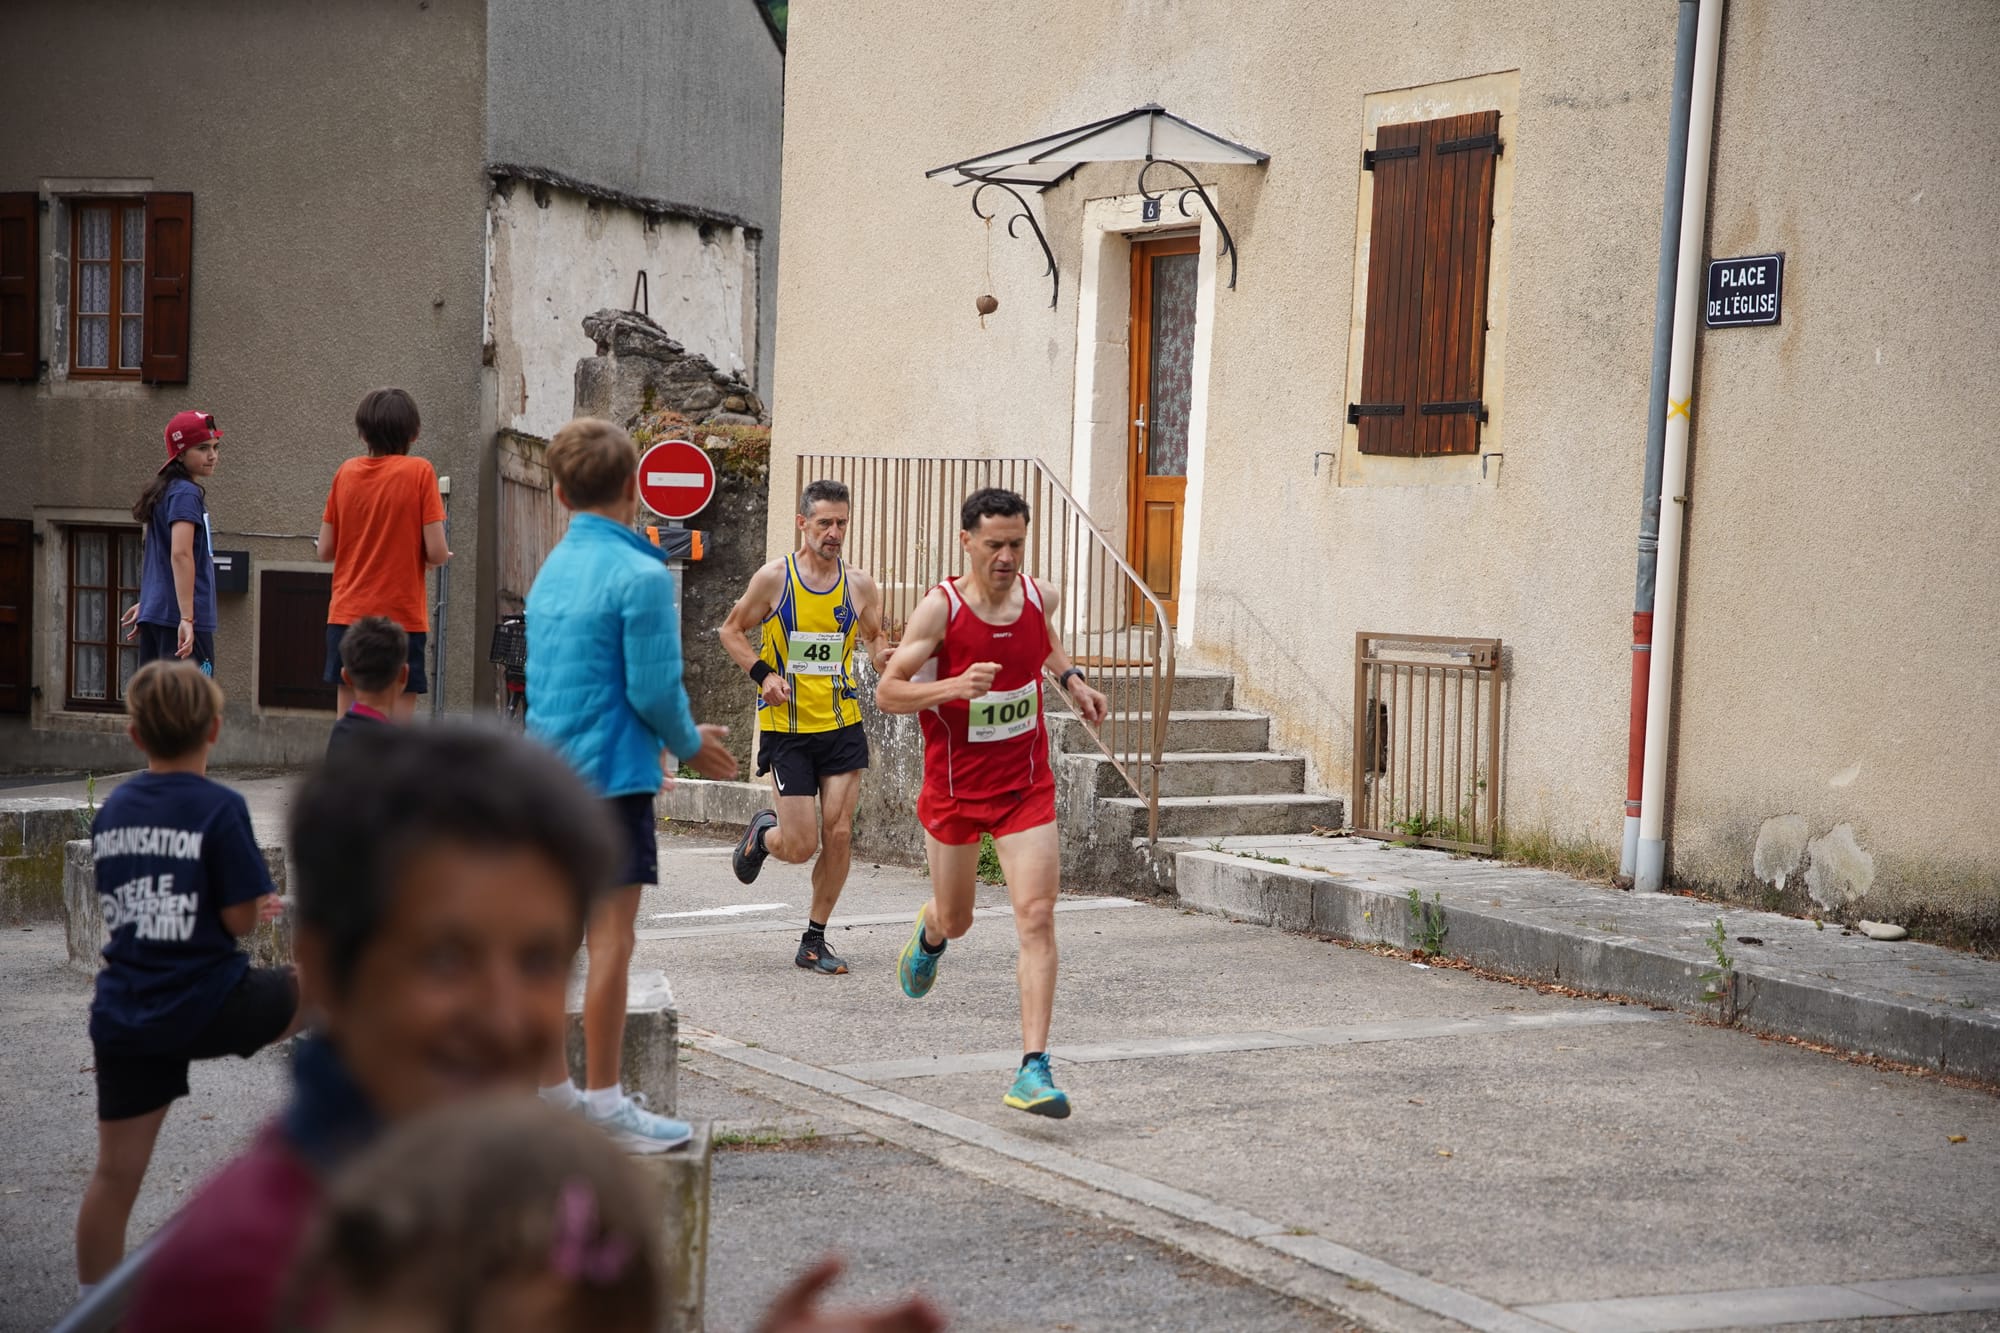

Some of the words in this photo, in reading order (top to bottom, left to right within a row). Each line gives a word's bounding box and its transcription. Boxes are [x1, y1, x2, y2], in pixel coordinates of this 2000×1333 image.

[1147, 203, 1154, 217] 6
[1720, 266, 1766, 287] PLACE
[1709, 300, 1722, 317] DE
[1724, 292, 1775, 315] L'ÉGLISE
[803, 643, 831, 661] 48
[982, 699, 1030, 725] 100
[94, 826, 203, 860] ORGANISATION
